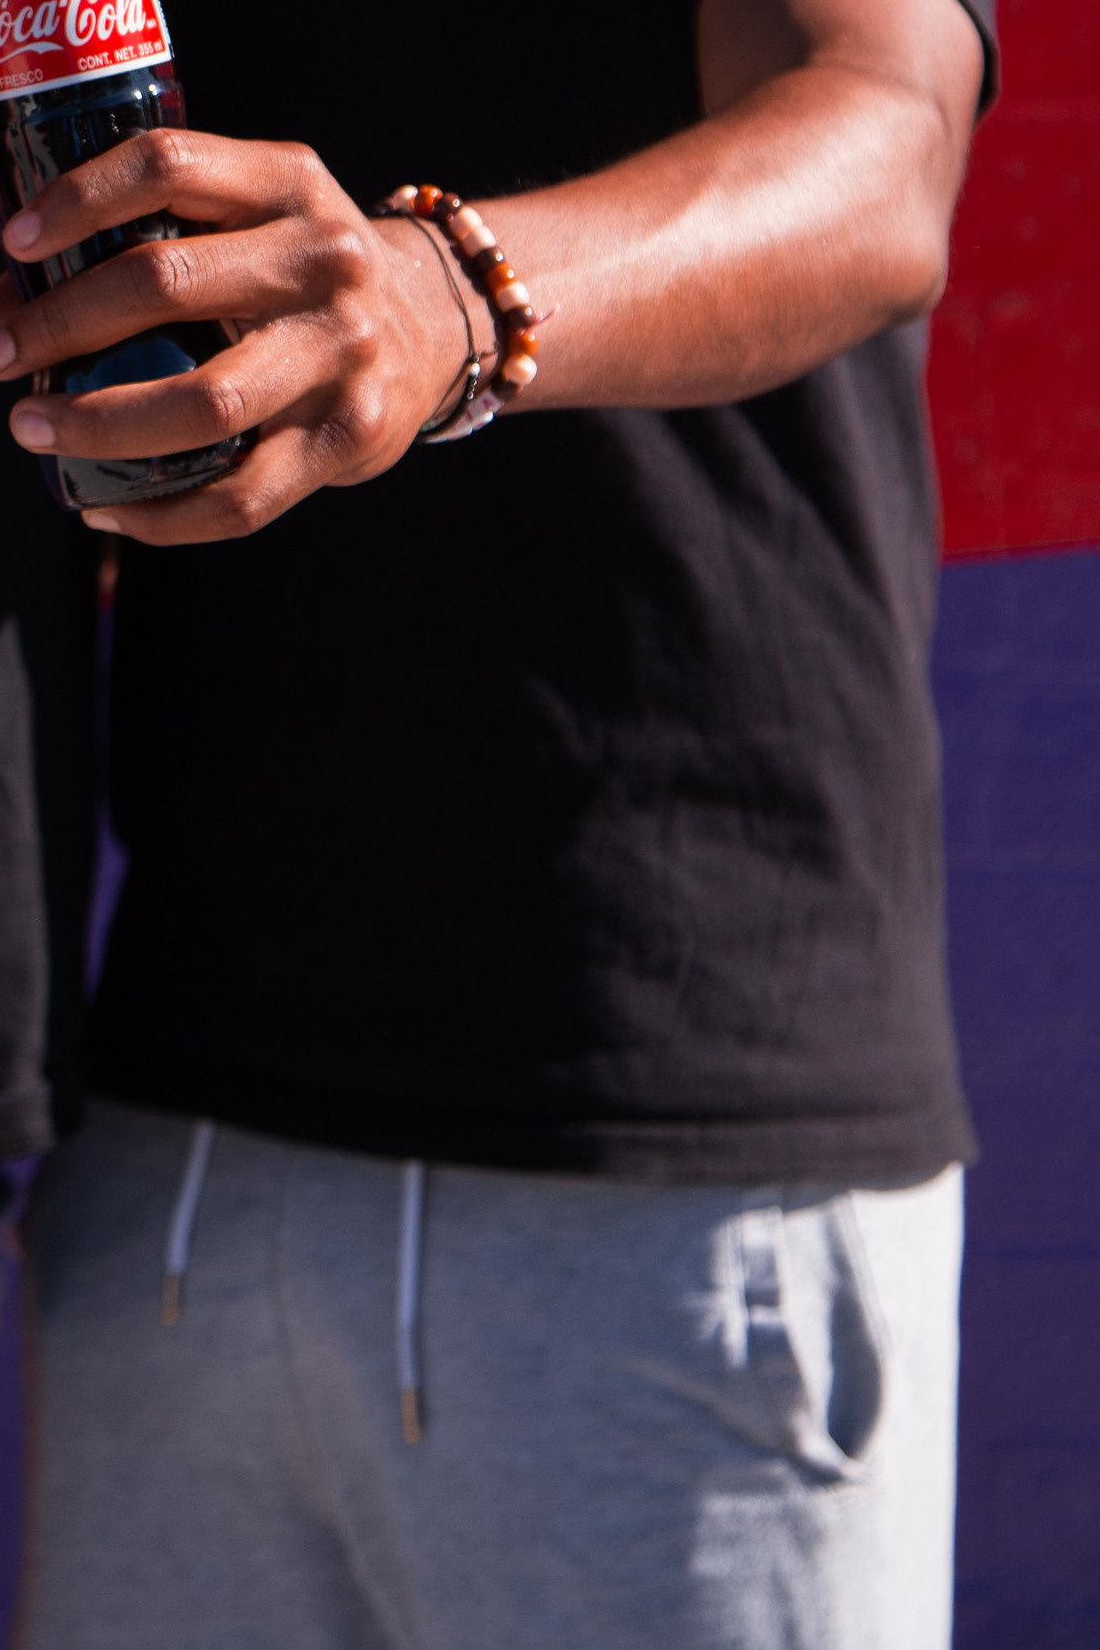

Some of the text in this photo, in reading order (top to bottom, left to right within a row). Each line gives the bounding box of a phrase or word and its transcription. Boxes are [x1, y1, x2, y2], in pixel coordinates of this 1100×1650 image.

[78, 53, 113, 72] CONT.
[115, 46, 138, 63] NET.
[139, 42, 154, 57] 355
